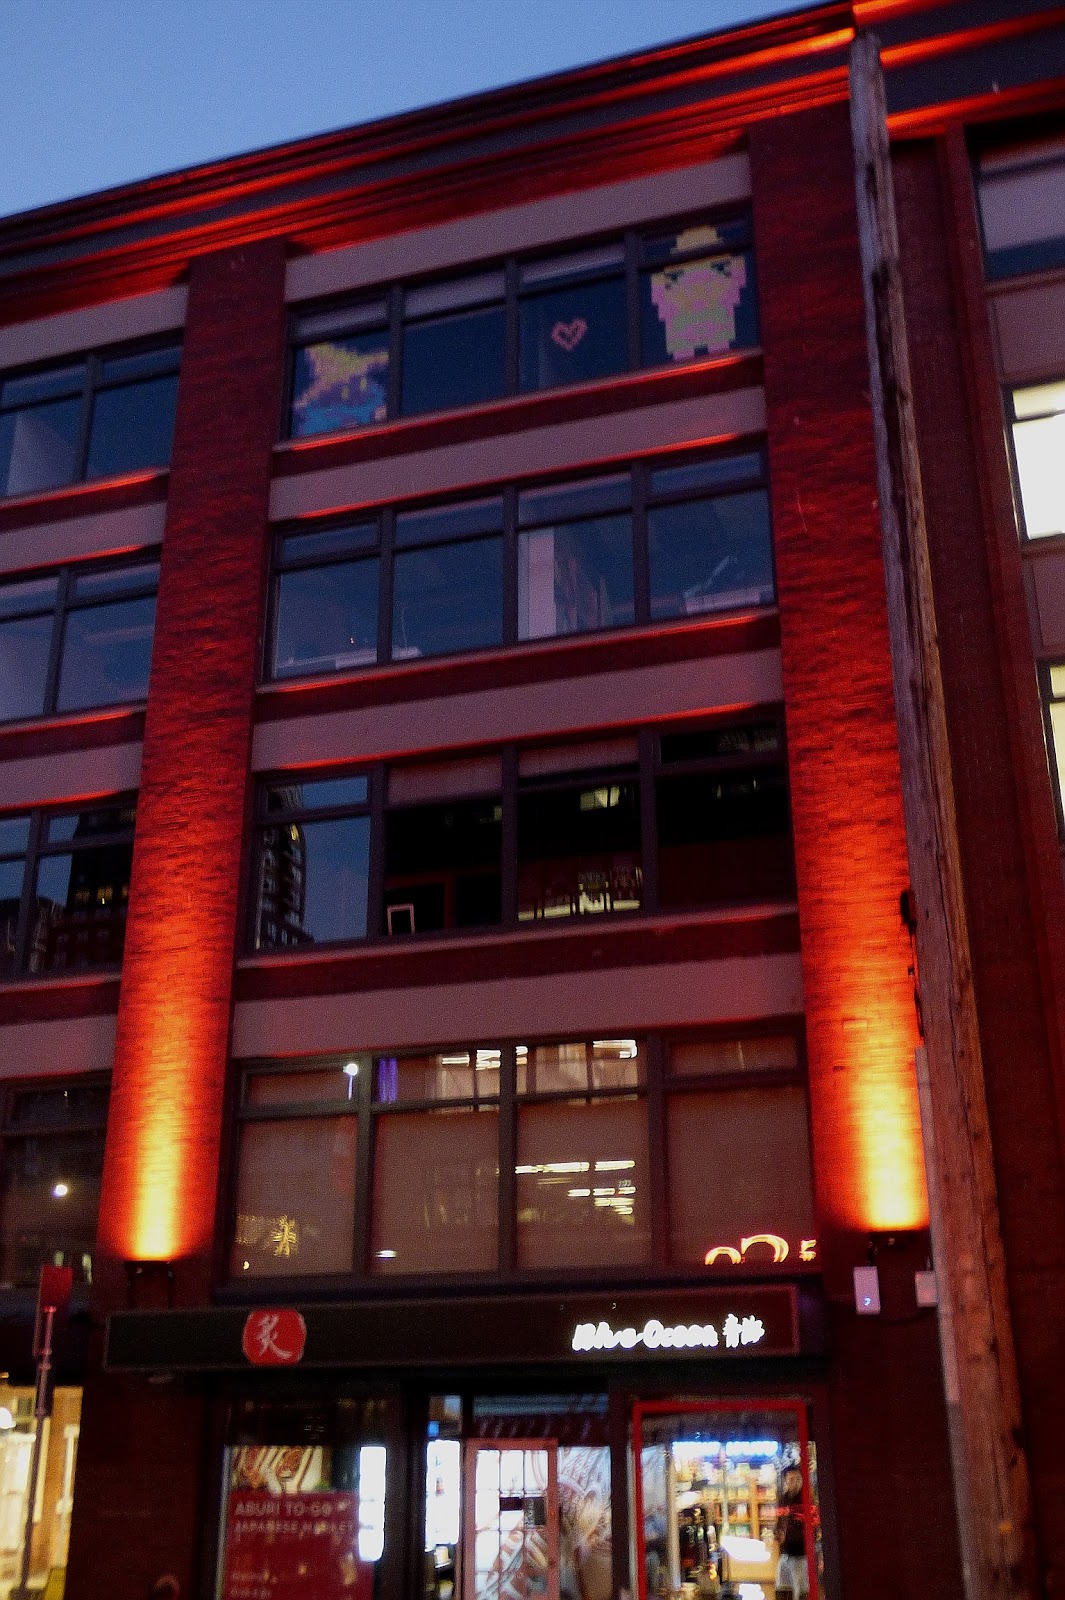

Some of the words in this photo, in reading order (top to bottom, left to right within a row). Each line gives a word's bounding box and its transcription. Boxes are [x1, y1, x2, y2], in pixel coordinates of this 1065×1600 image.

[572, 1320, 642, 1351] Blue
[643, 1319, 719, 1349] Ocean
[234, 1500, 280, 1517] ABURI
[284, 1499, 333, 1518] TO-GO
[234, 1520, 299, 1534] JAPANESE
